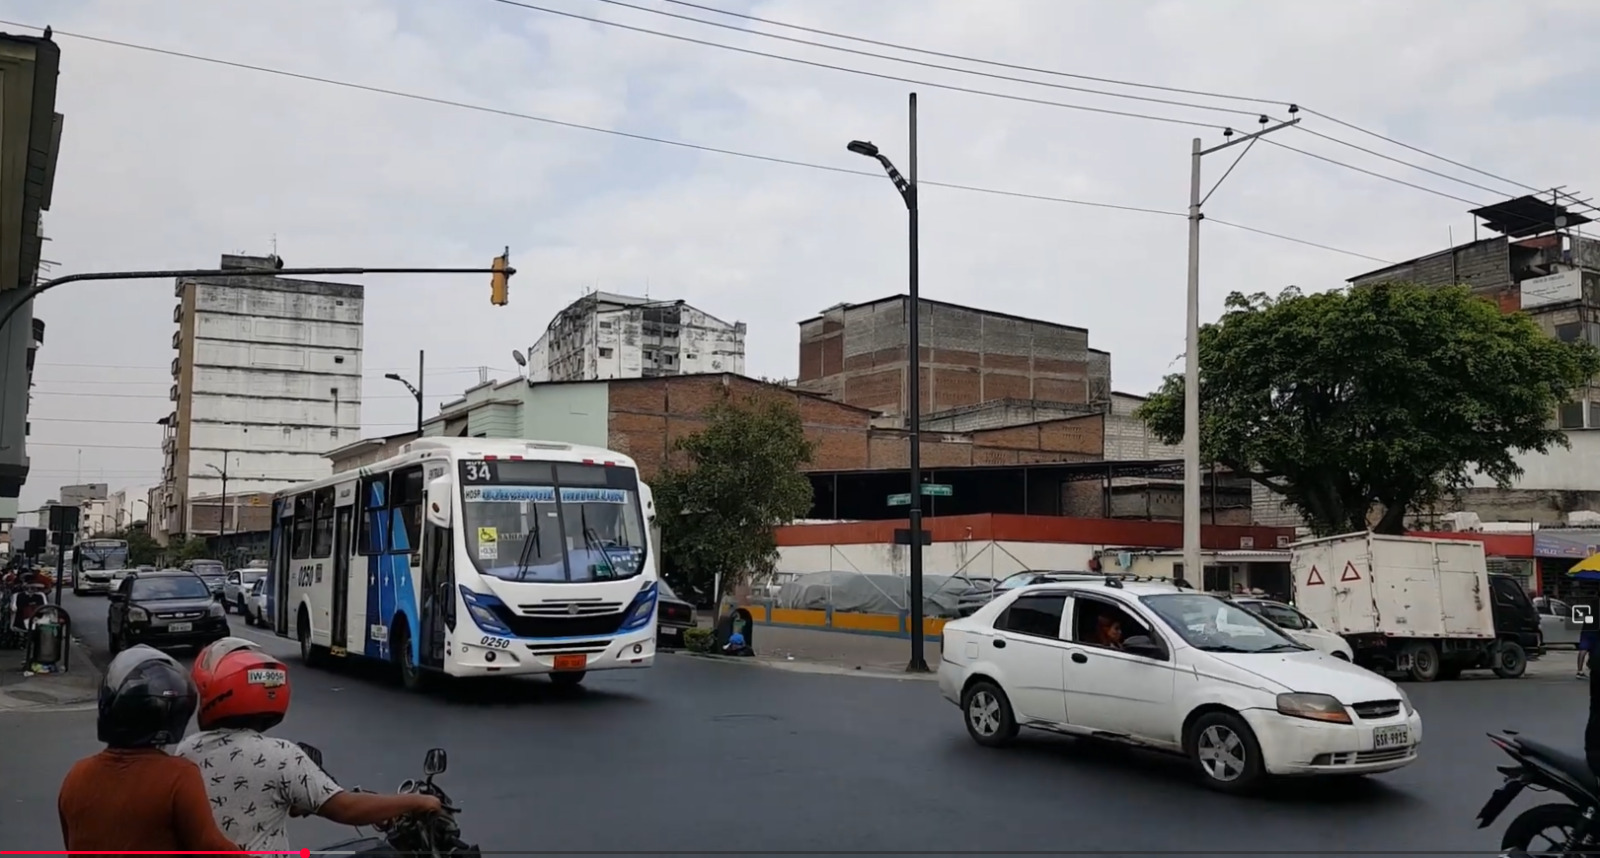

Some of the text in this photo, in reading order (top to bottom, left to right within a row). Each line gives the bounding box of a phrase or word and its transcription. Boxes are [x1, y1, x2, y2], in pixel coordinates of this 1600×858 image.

[466, 465, 491, 481] 34
[298, 565, 314, 587] 0250
[480, 636, 510, 649] 0250
